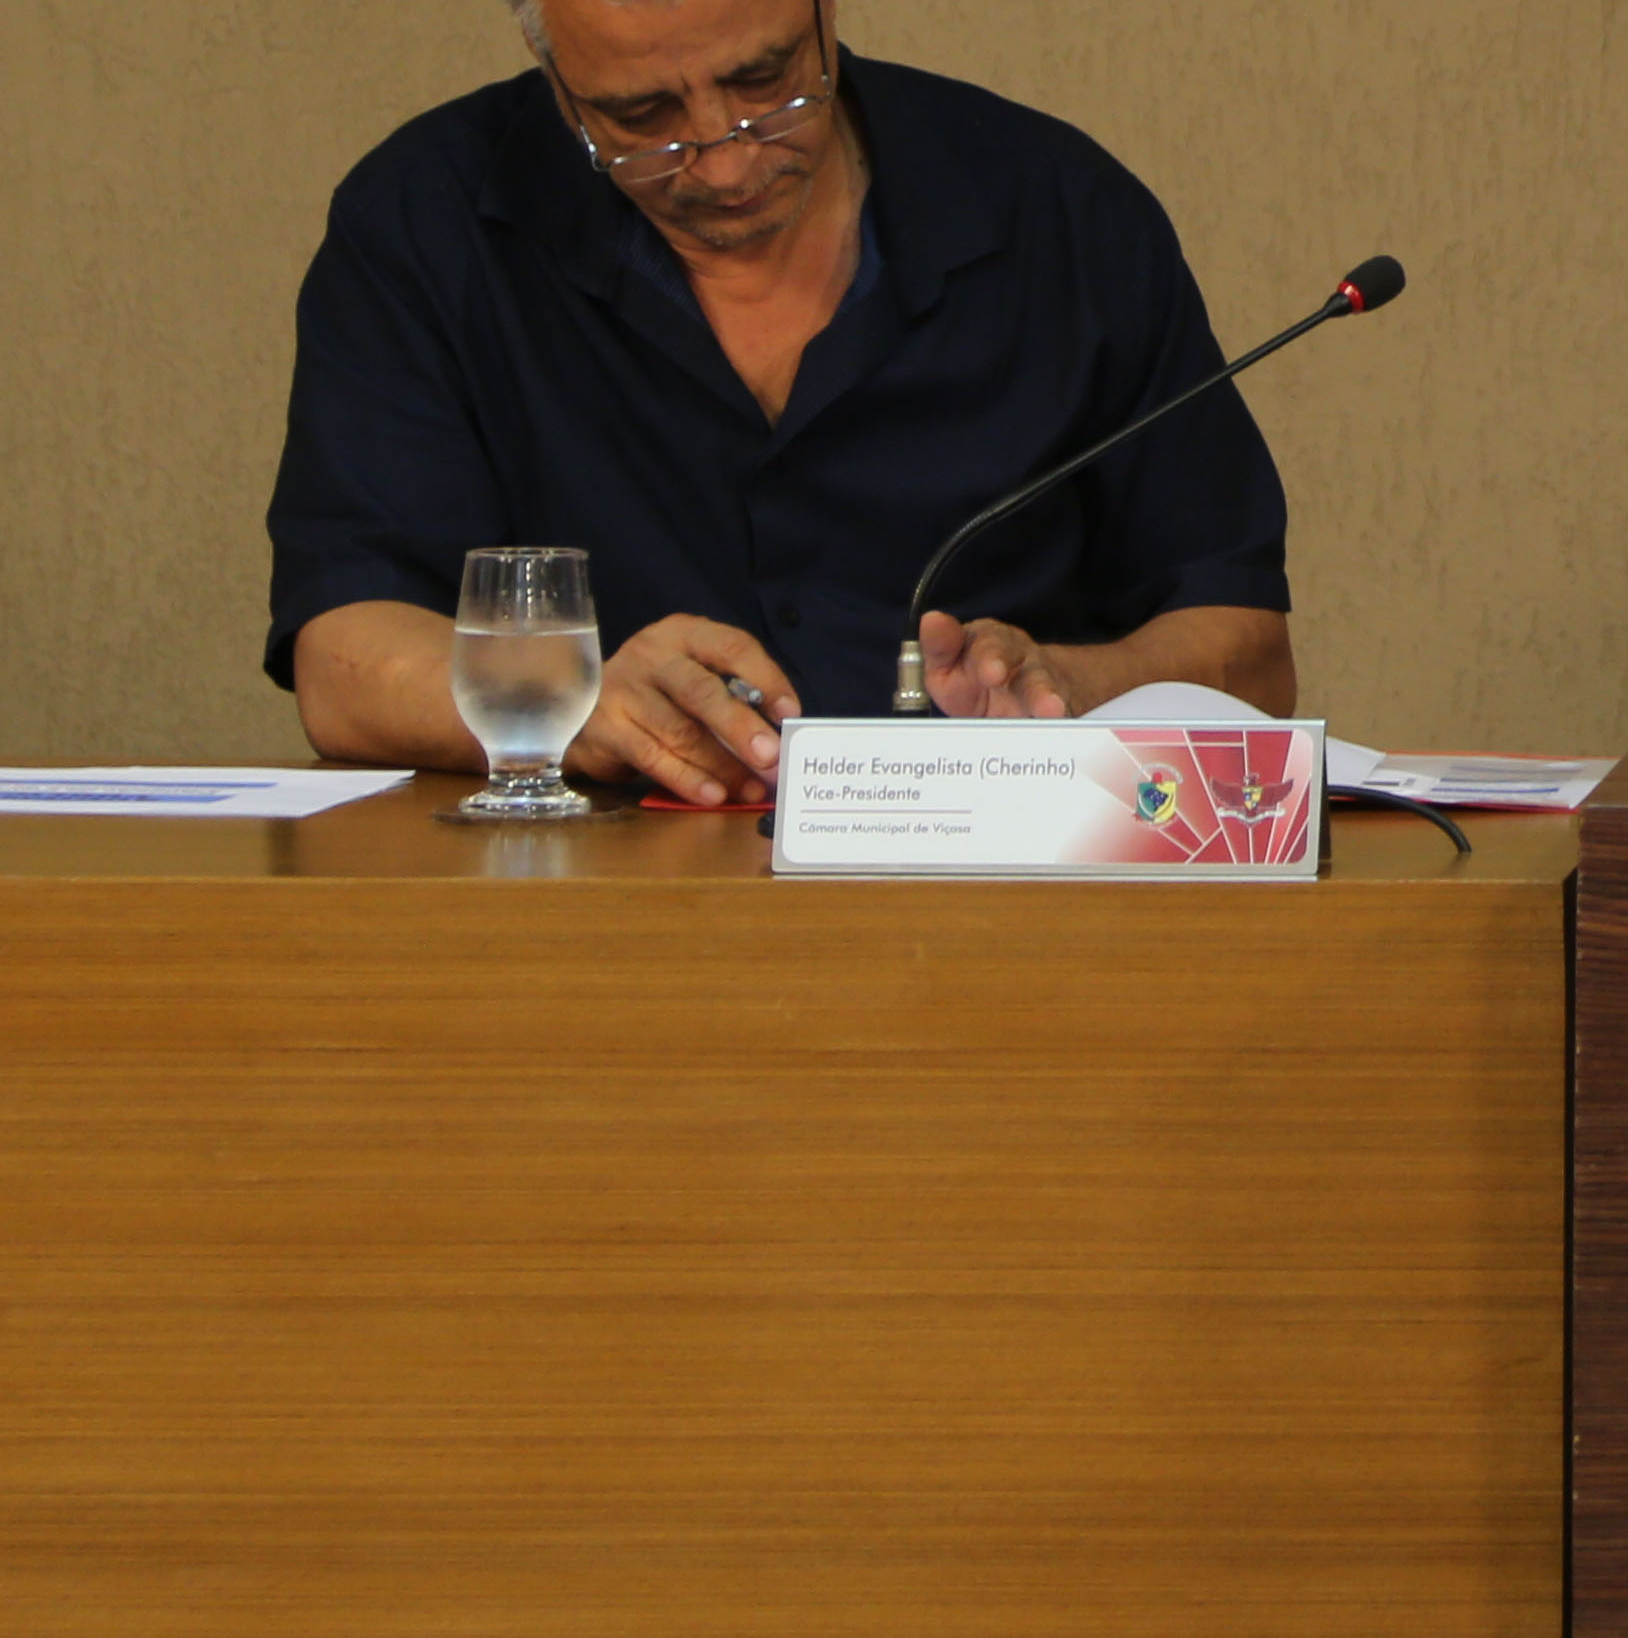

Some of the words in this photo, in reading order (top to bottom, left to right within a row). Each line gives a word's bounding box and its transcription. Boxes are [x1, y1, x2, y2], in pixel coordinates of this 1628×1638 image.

[803, 757, 864, 775] Helder
[871, 757, 972, 779] Evangelista
[979, 757, 1075, 779] (Cherinho)
[803, 785, 920, 801] Vice-Presidente
[799, 822, 847, 834] Câmara
[851, 823, 909, 836] Municipal
[913, 823, 928, 834] de
[932, 823, 971, 836] Viçosa
